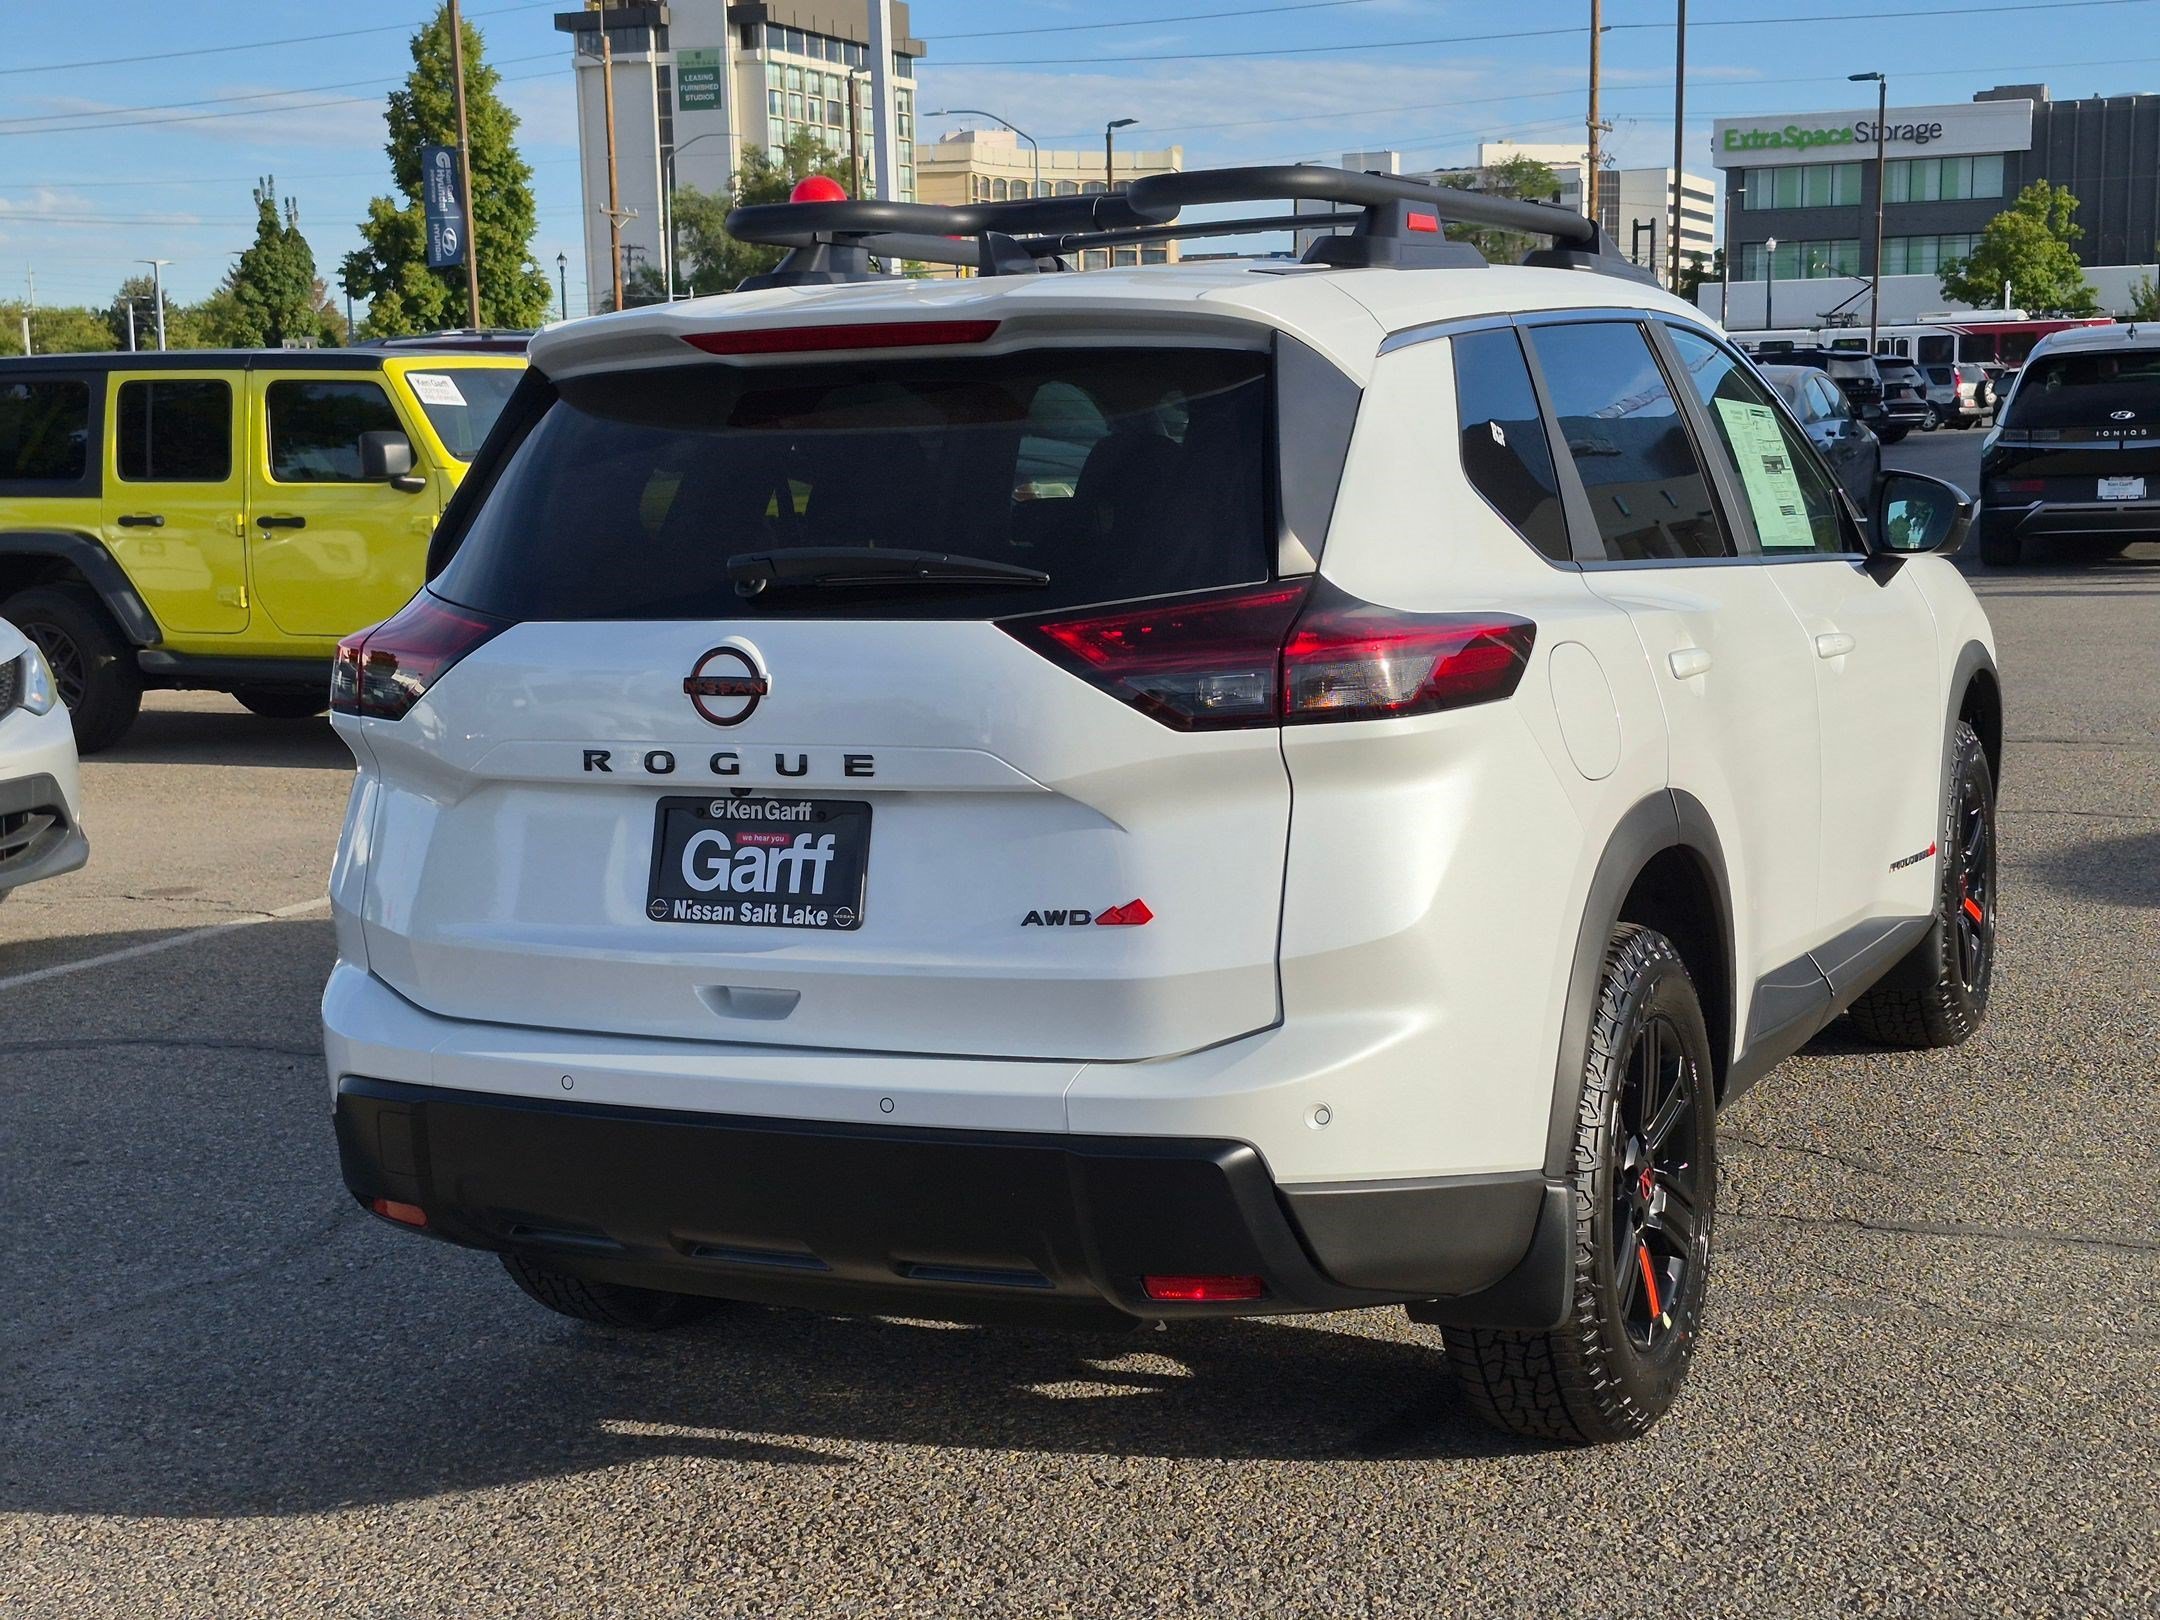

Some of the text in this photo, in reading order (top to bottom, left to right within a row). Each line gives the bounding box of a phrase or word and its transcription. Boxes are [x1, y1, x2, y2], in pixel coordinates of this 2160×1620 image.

[684, 74, 714, 82] LEASING
[680, 83, 719, 91] FURNISHED
[685, 93, 715, 101] STUDIOS
[436, 169, 449, 212] Hyundai
[433, 223, 442, 262] HYUNDAI
[685, 680, 766, 694] NISSAN
[582, 749, 876, 777] ROGUE
[754, 834, 770, 842] hear
[770, 835, 785, 844] you
[681, 828, 836, 895] Garff
[673, 899, 829, 927] Nissan Salt Lake
[1021, 910, 1092, 926] AWD
